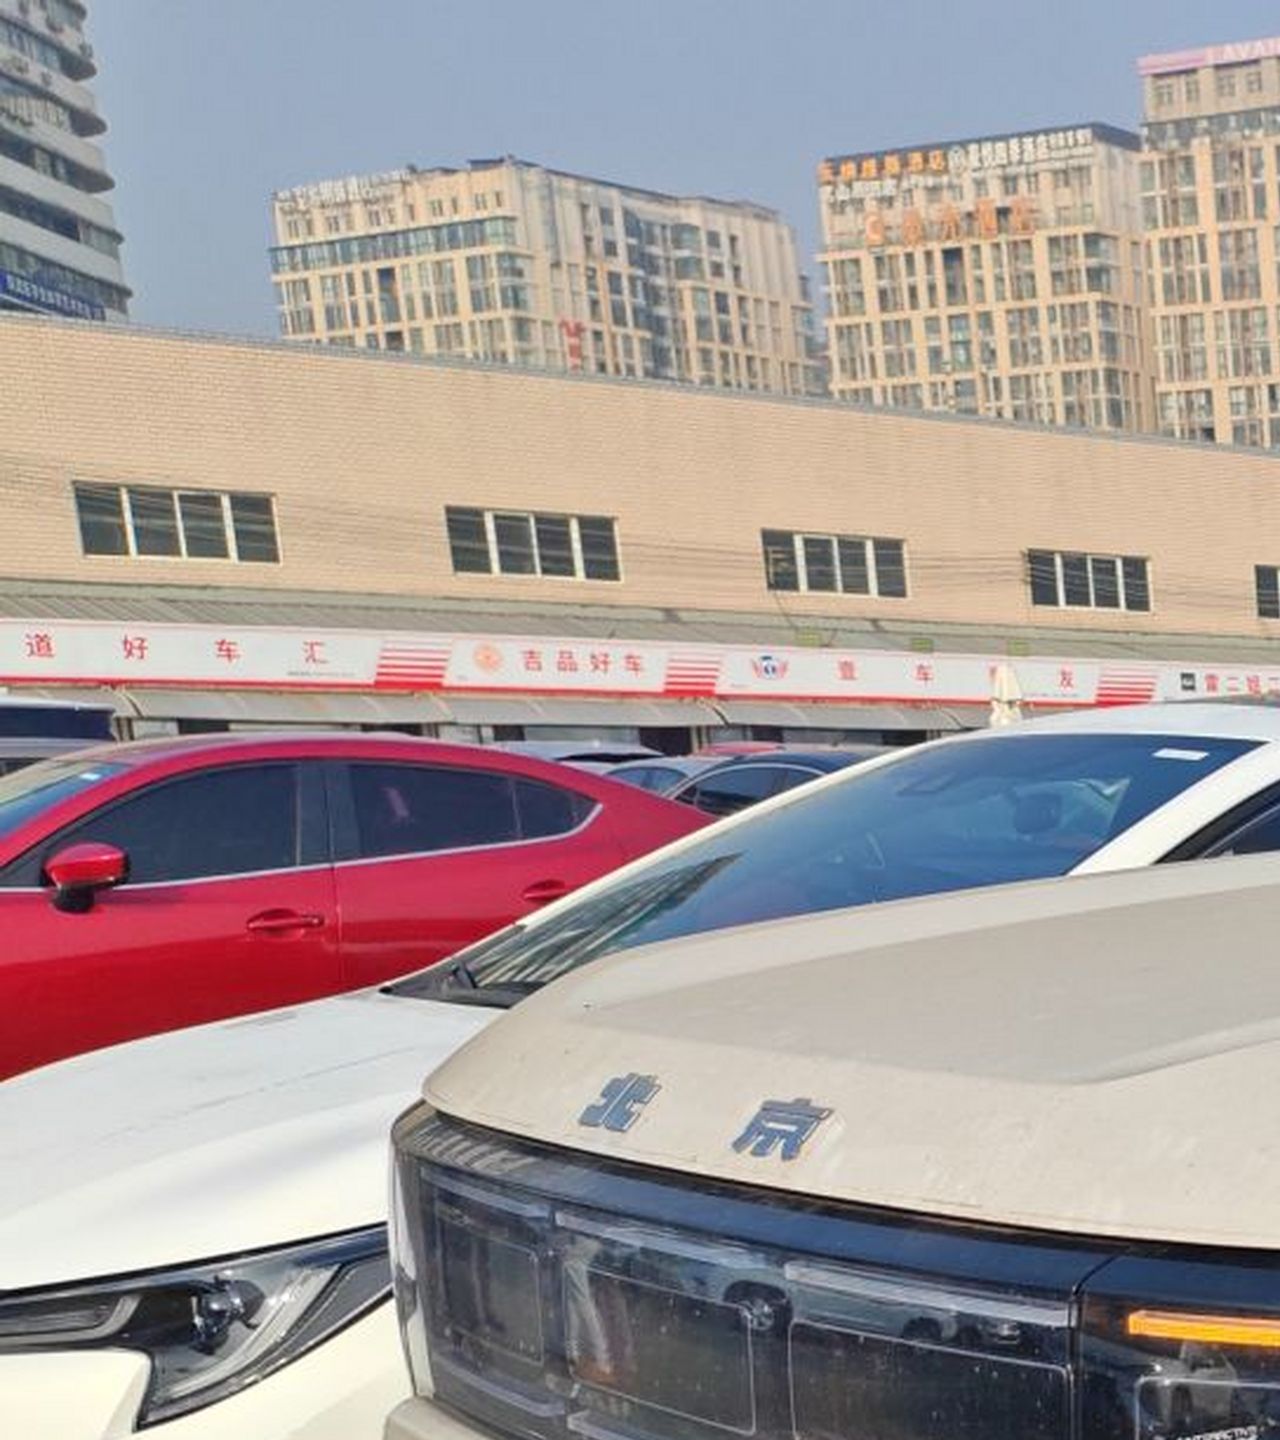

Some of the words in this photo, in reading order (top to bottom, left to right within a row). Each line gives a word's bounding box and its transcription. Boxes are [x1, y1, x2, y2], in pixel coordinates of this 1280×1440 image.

[521, 649, 644, 678] 吉品好车
[577, 1072, 834, 1162] 北京
